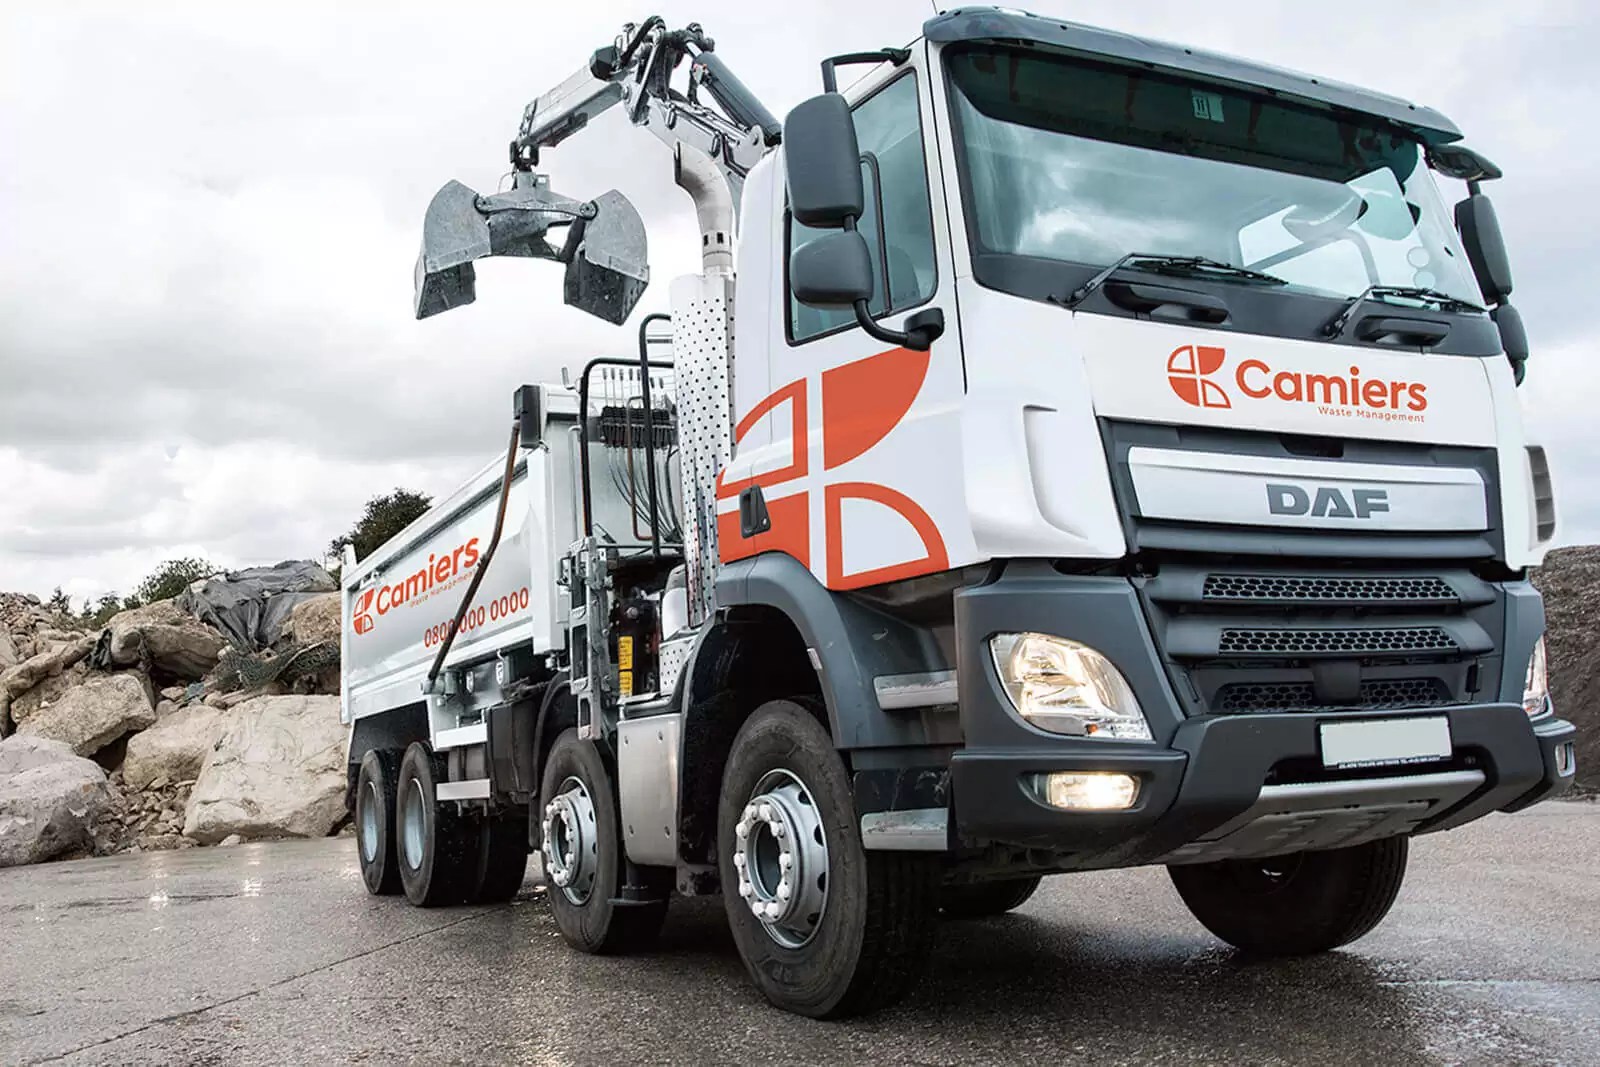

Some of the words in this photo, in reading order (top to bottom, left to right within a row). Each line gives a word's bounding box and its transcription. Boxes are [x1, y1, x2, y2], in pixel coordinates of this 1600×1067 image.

[1236, 360, 1428, 412] Camiers
[1318, 406, 1352, 417] Waste
[1356, 409, 1425, 423] Management
[1266, 483, 1390, 518] DAF
[376, 537, 479, 615] Camiers
[490, 586, 529, 621] 0000
